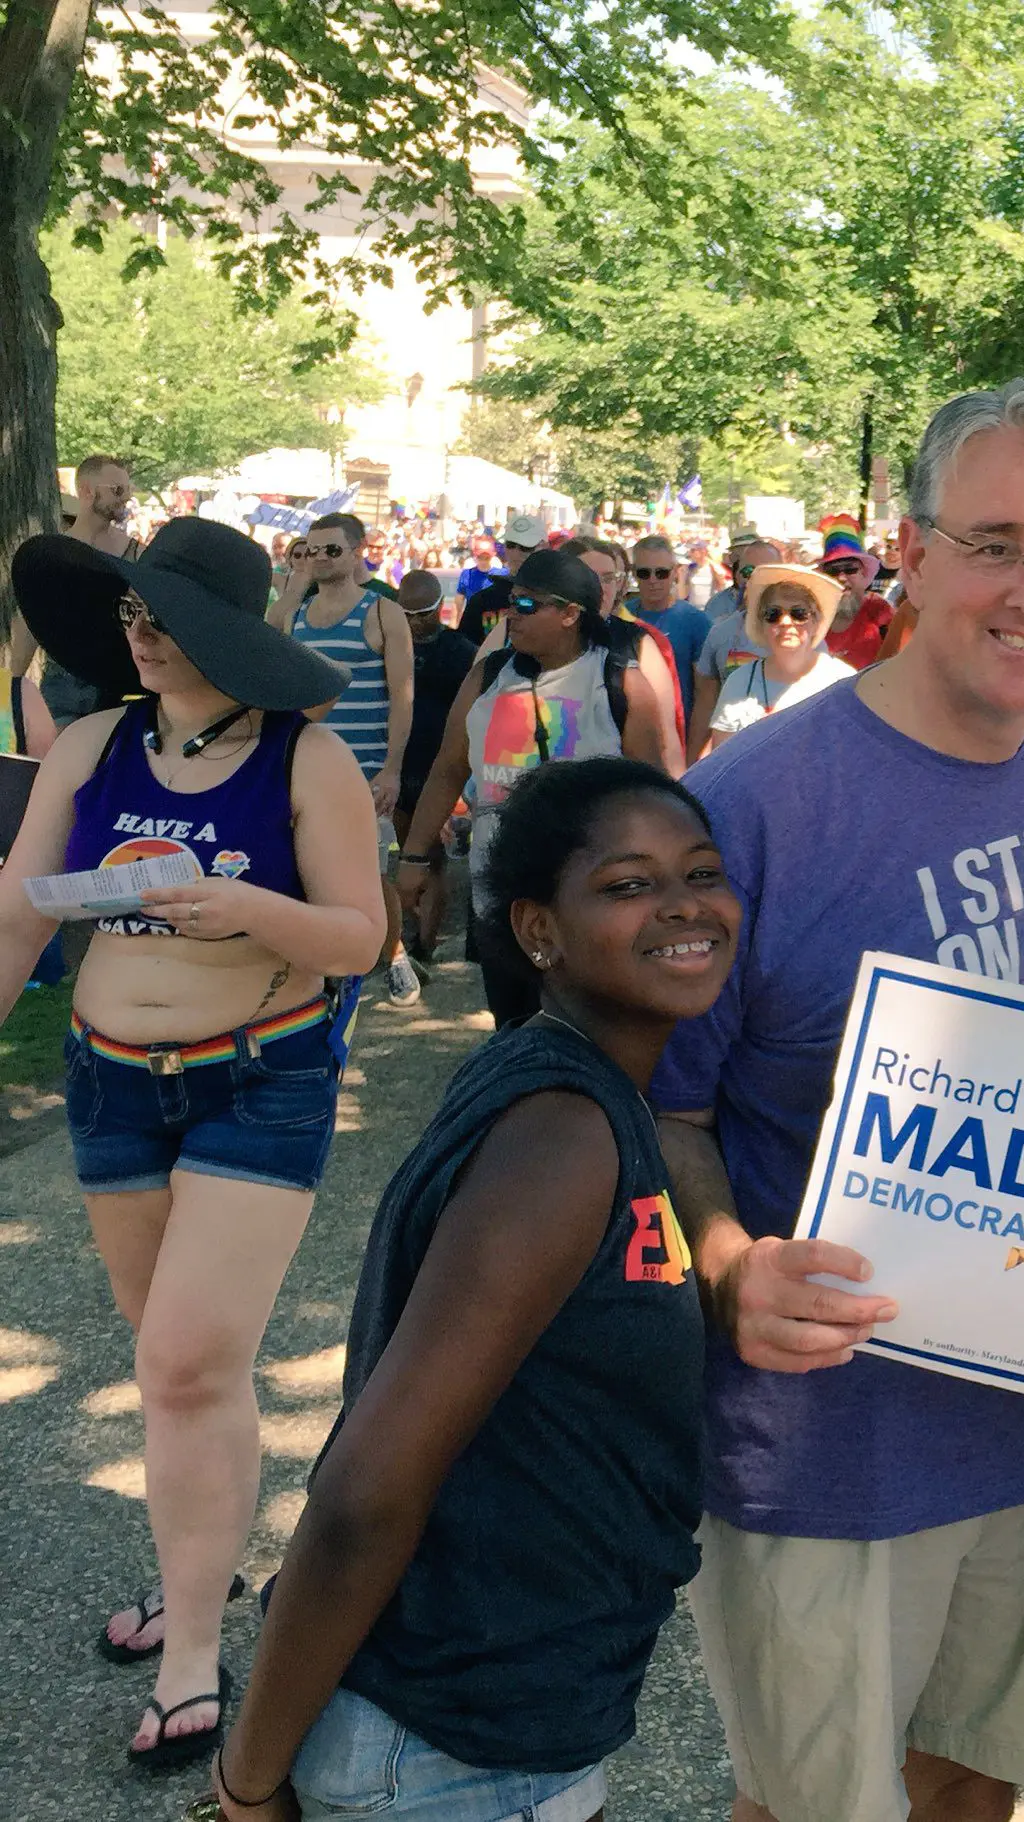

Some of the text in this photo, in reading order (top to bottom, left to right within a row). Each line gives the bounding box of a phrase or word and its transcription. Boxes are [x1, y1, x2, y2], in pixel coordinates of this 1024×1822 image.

[483, 764, 520, 784] NAT
[113, 813, 217, 843] HAVE A
[916, 867, 947, 940] I
[872, 1046, 1022, 1114] Richard
[923, 1338, 933, 1348] By
